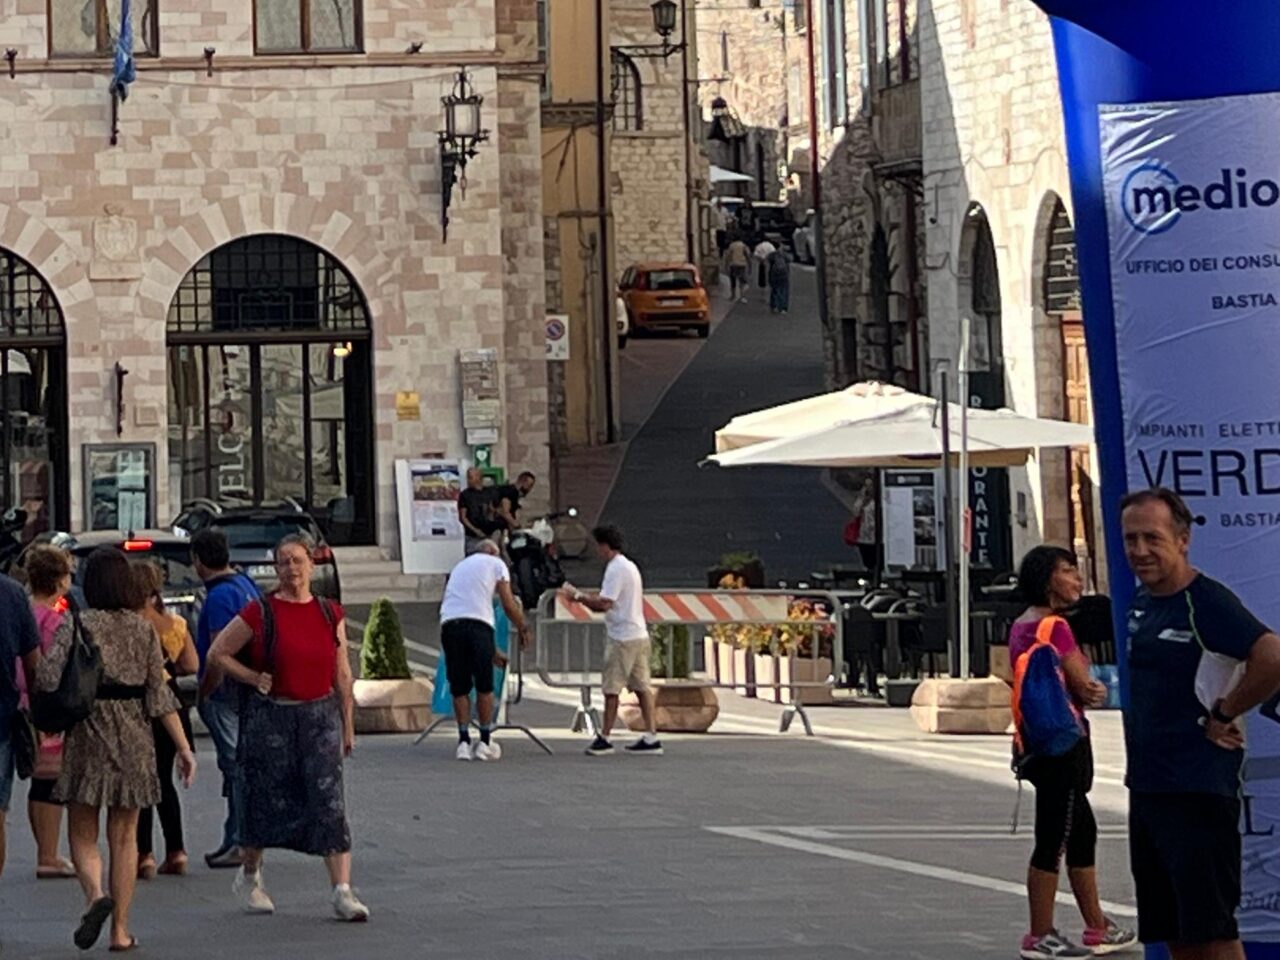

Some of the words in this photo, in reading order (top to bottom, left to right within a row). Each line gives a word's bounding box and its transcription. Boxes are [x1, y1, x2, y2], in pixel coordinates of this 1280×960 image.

[1131, 167, 1279, 215] medio
[1126, 258, 1185, 274] UFFICIO
[1189, 257, 1218, 272] DEI
[1211, 292, 1278, 310] BASTIA
[1218, 421, 1280, 438] ELETT
